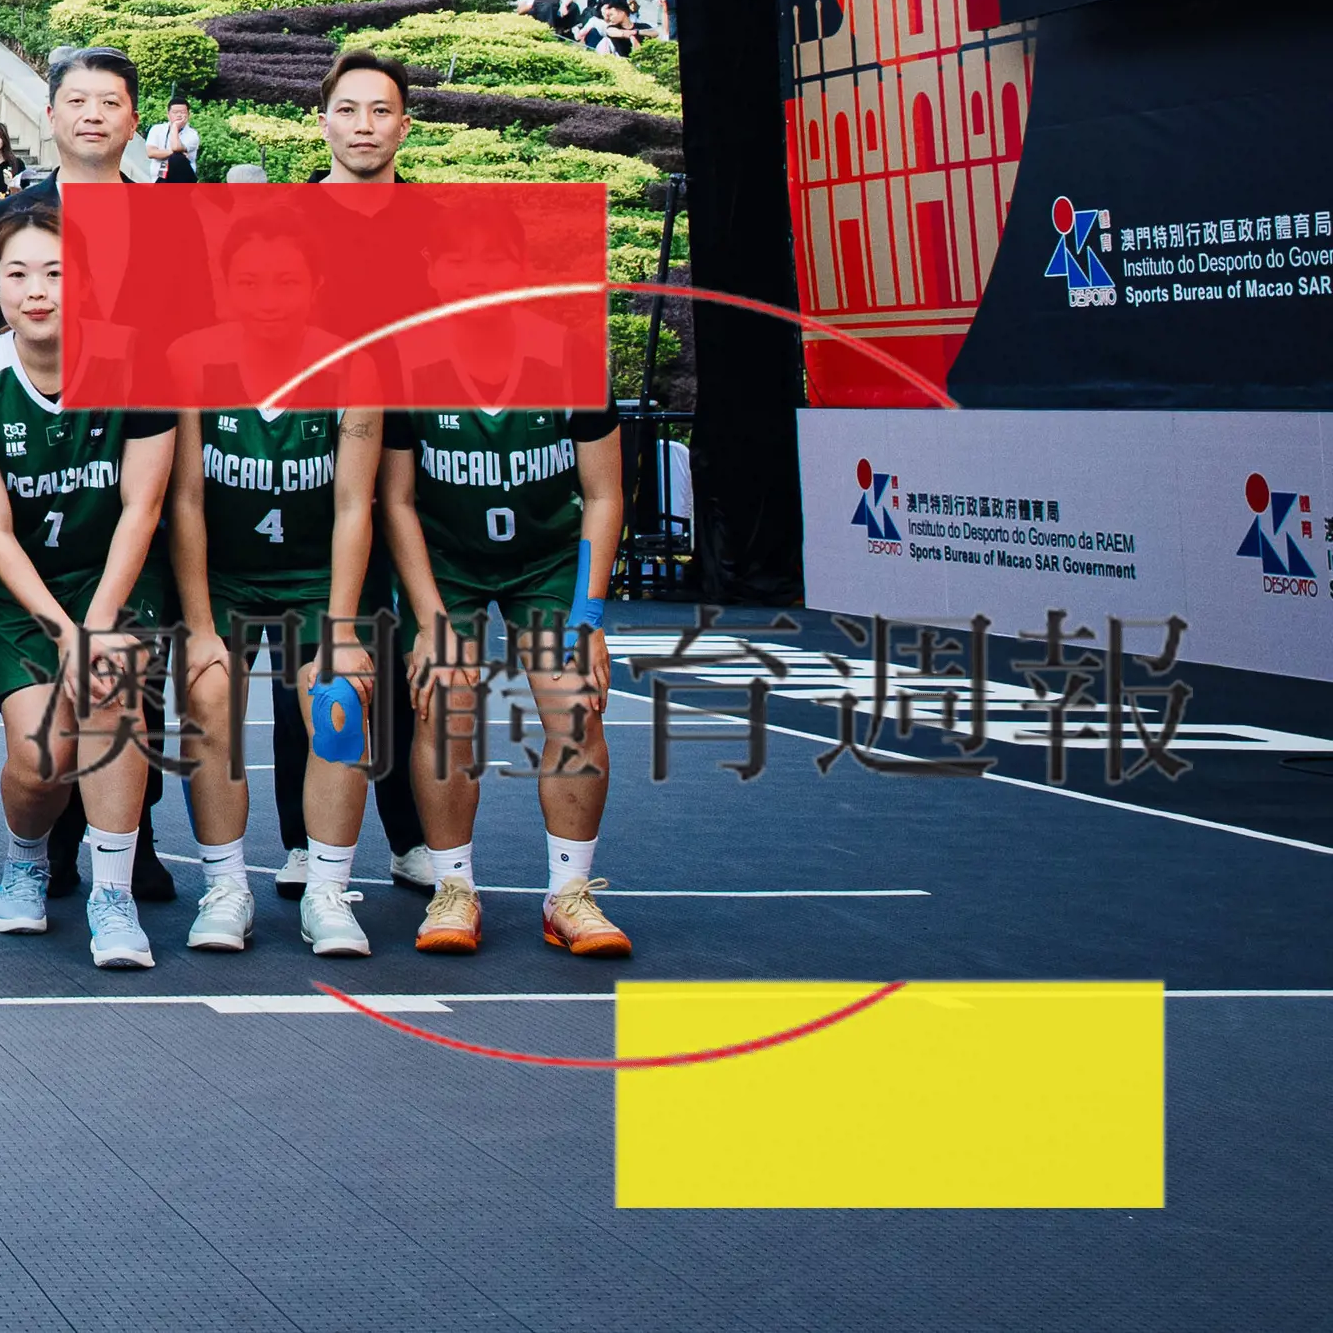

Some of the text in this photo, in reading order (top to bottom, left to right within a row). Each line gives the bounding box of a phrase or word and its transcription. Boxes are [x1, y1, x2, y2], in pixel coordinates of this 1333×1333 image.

[1121, 210, 1333, 252] 澳門特別行政區政府體育局
[1123, 255, 1174, 277] Instituto
[1178, 254, 1195, 275] do
[1198, 250, 1262, 278] Desporto
[1266, 248, 1285, 270] do
[1125, 274, 1333, 308] Sports Bureau of Macao SAR
[486, 507, 516, 542] 0
[906, 492, 1060, 524] 澳門特別行政區政府體育局
[43, 510, 64, 548] 7
[254, 508, 284, 544] 4
[908, 518, 1135, 554] Instituto do Desporto do Governo da RAEM
[909, 543, 1137, 580] Sports Bureau of Macao SAR Government
[1262, 575, 1318, 598] DESPORTO
